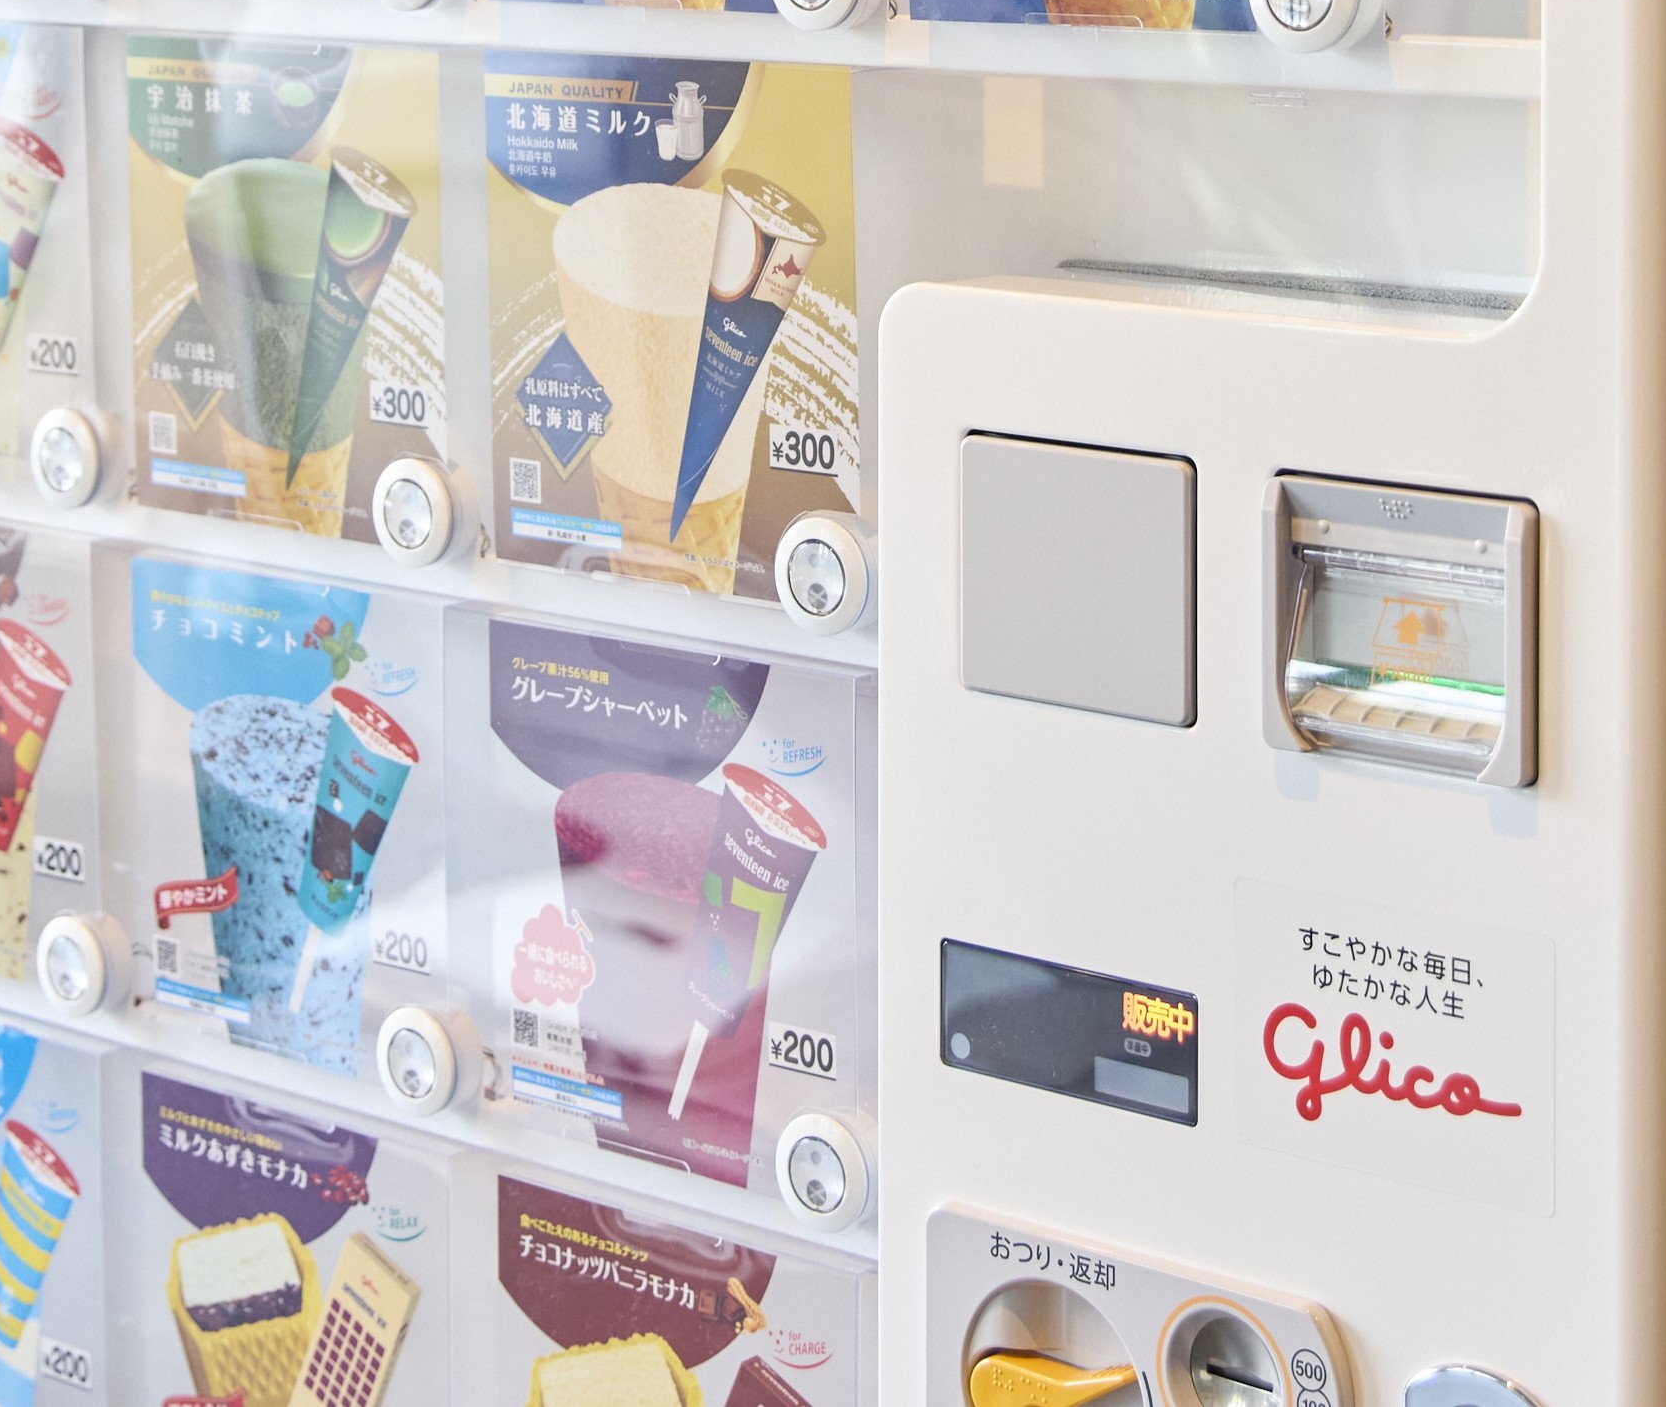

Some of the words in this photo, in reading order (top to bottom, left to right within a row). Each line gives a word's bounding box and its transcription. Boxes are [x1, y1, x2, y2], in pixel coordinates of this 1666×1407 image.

[148, 64, 186, 77] JAPAN
[146, 83, 252, 115] 宇治抹茶
[508, 81, 554, 95] JAPAN
[561, 85, 625, 100] QUALITY
[506, 103, 652, 137] 北海道ミルク
[507, 134, 555, 149] Hokkaido
[556, 137, 579, 152] Milk
[507, 150, 553, 163] 北海道牛奶
[507, 163, 539, 177] 홋카이도
[540, 165, 558, 178] 우유
[722, 316, 747, 338] Glico
[704, 325, 742, 364] seventeen
[743, 350, 759, 368] ice
[372, 386, 425, 423] ¥300
[524, 376, 604, 402] 乳原料はすべて
[524, 402, 605, 436] 北海道産
[772, 430, 835, 470] ¥300
[151, 608, 298, 655] チョコミント
[511, 656, 609, 686] グレープ果汁56%使用
[511, 676, 689, 730] グレープシャーベット
[782, 738, 796, 750] for
[782, 745, 823, 764] REFRESH
[37, 842, 82, 877] ¥200
[744, 827, 778, 859] Glico
[723, 831, 772, 885] seventeen
[772, 871, 790, 892] ice
[374, 929, 428, 968] ¥200
[1298, 925, 1485, 990] すこやかな毎日、
[1312, 964, 1465, 1021] ゆたかな人生
[1122, 991, 1194, 1044] 販売中
[770, 1029, 834, 1073] ¥200
[1262, 1002, 1523, 1122] Glico
[159, 1123, 308, 1190] ミルクあずきモナカ
[389, 1216, 419, 1229] RELAX
[519, 1212, 650, 1263] 食べごたえのあるチョコ&ナッツ
[518, 1234, 696, 1311] チョコナッツバニラモナカ
[989, 1231, 1118, 1291] おつり・返却
[788, 1330, 802, 1342] for
[788, 1340, 827, 1356] CHARGE
[44, 1346, 90, 1383] ¥200
[1295, 1359, 1323, 1382] 500
